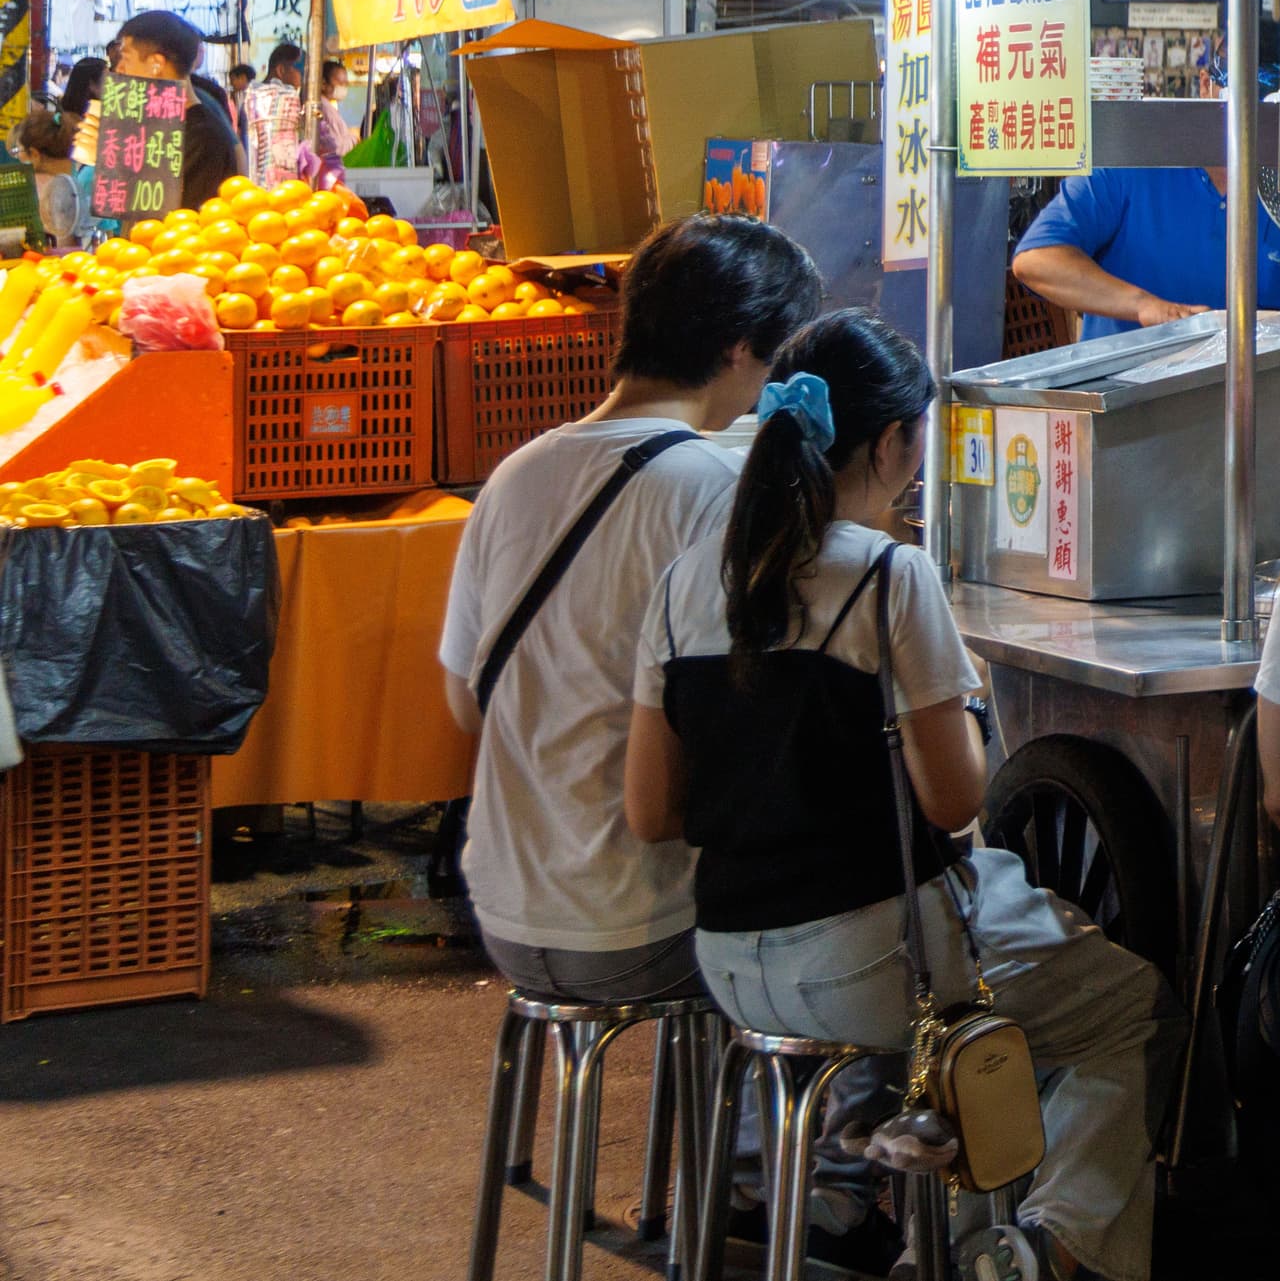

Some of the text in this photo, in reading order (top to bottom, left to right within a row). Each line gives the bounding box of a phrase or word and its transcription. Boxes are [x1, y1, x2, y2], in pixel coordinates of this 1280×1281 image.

[976, 20, 1067, 83] 補元氣
[102, 126, 183, 178] 香甜好喝
[896, 51, 929, 246] 加冰水
[132, 180, 164, 211] 100
[970, 438, 986, 473] 30
[1054, 420, 1074, 575] 謝謝惠顧
